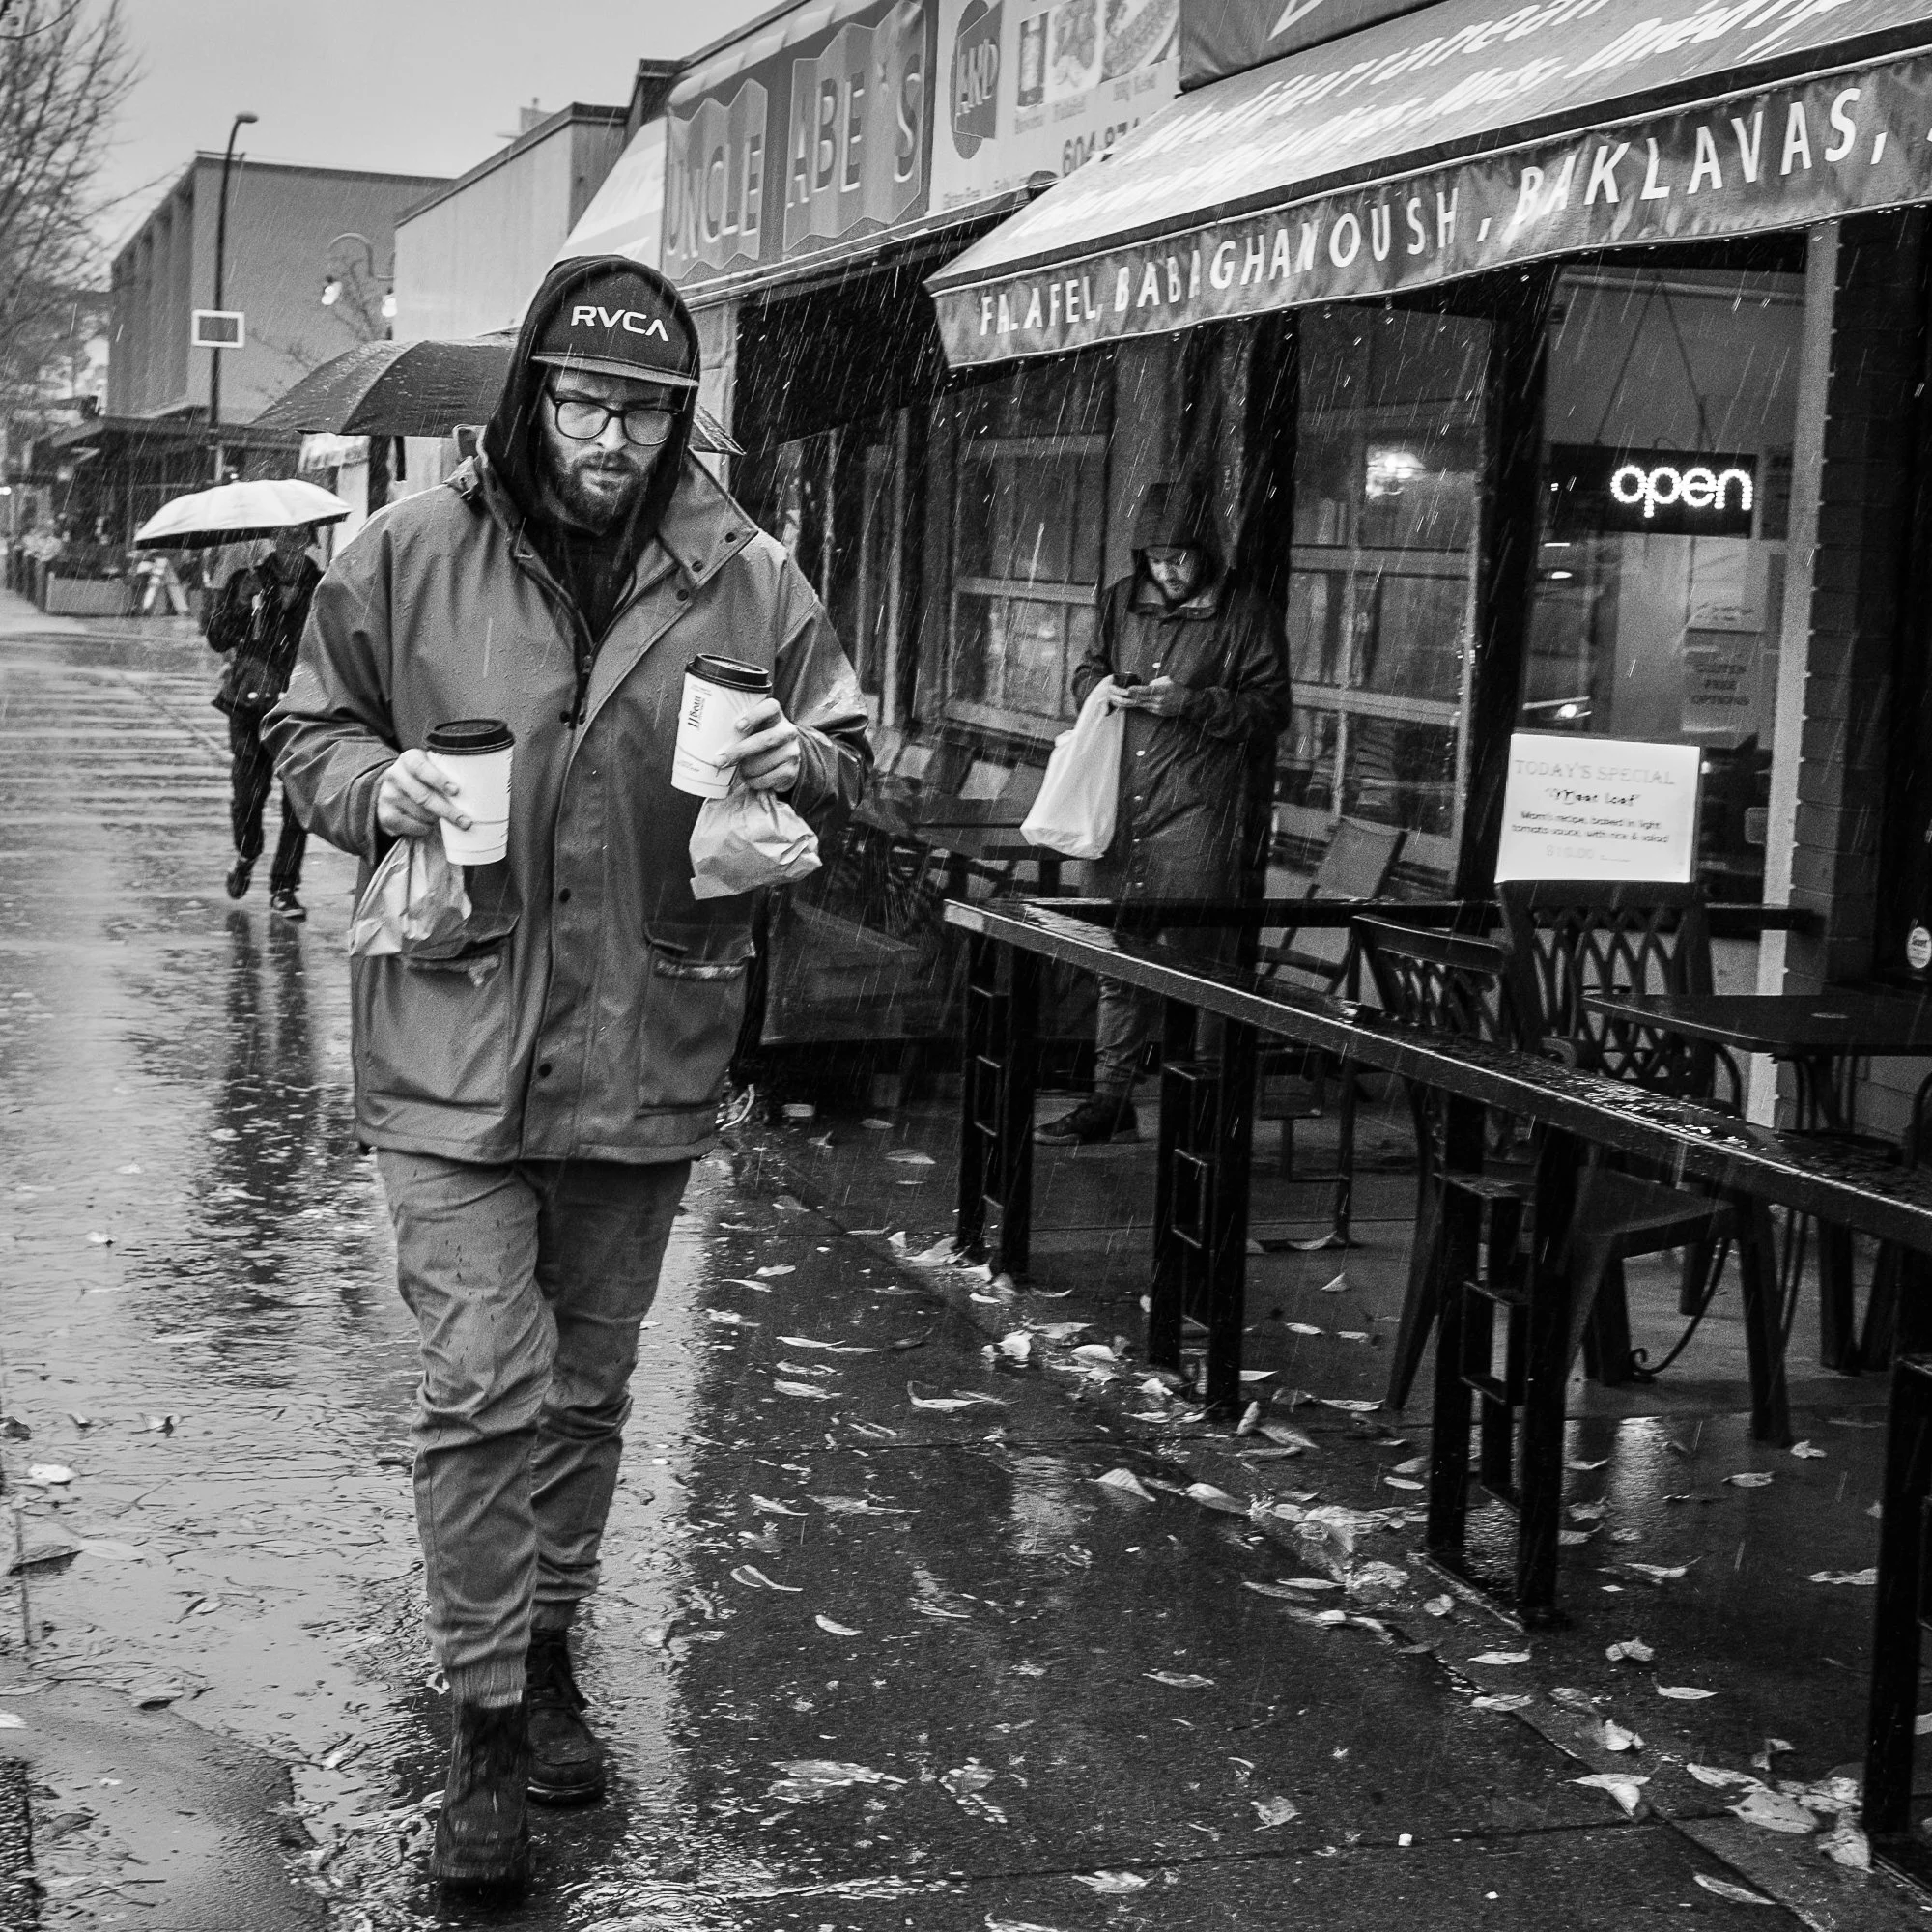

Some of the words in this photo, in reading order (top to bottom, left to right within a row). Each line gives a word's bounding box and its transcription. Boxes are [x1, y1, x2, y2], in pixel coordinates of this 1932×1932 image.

[955, 37, 1000, 116] AND
[1403, 56, 1568, 125] Nuts,
[664, 133, 762, 259] UNCLE
[786, 52, 923, 209] ABE'S
[1505, 87, 1888, 226] BAKLAVAS,
[1610, 464, 1753, 519] open
[1514, 759, 1593, 780] TODAY'S
[1596, 765, 1676, 785] SPECIAL
